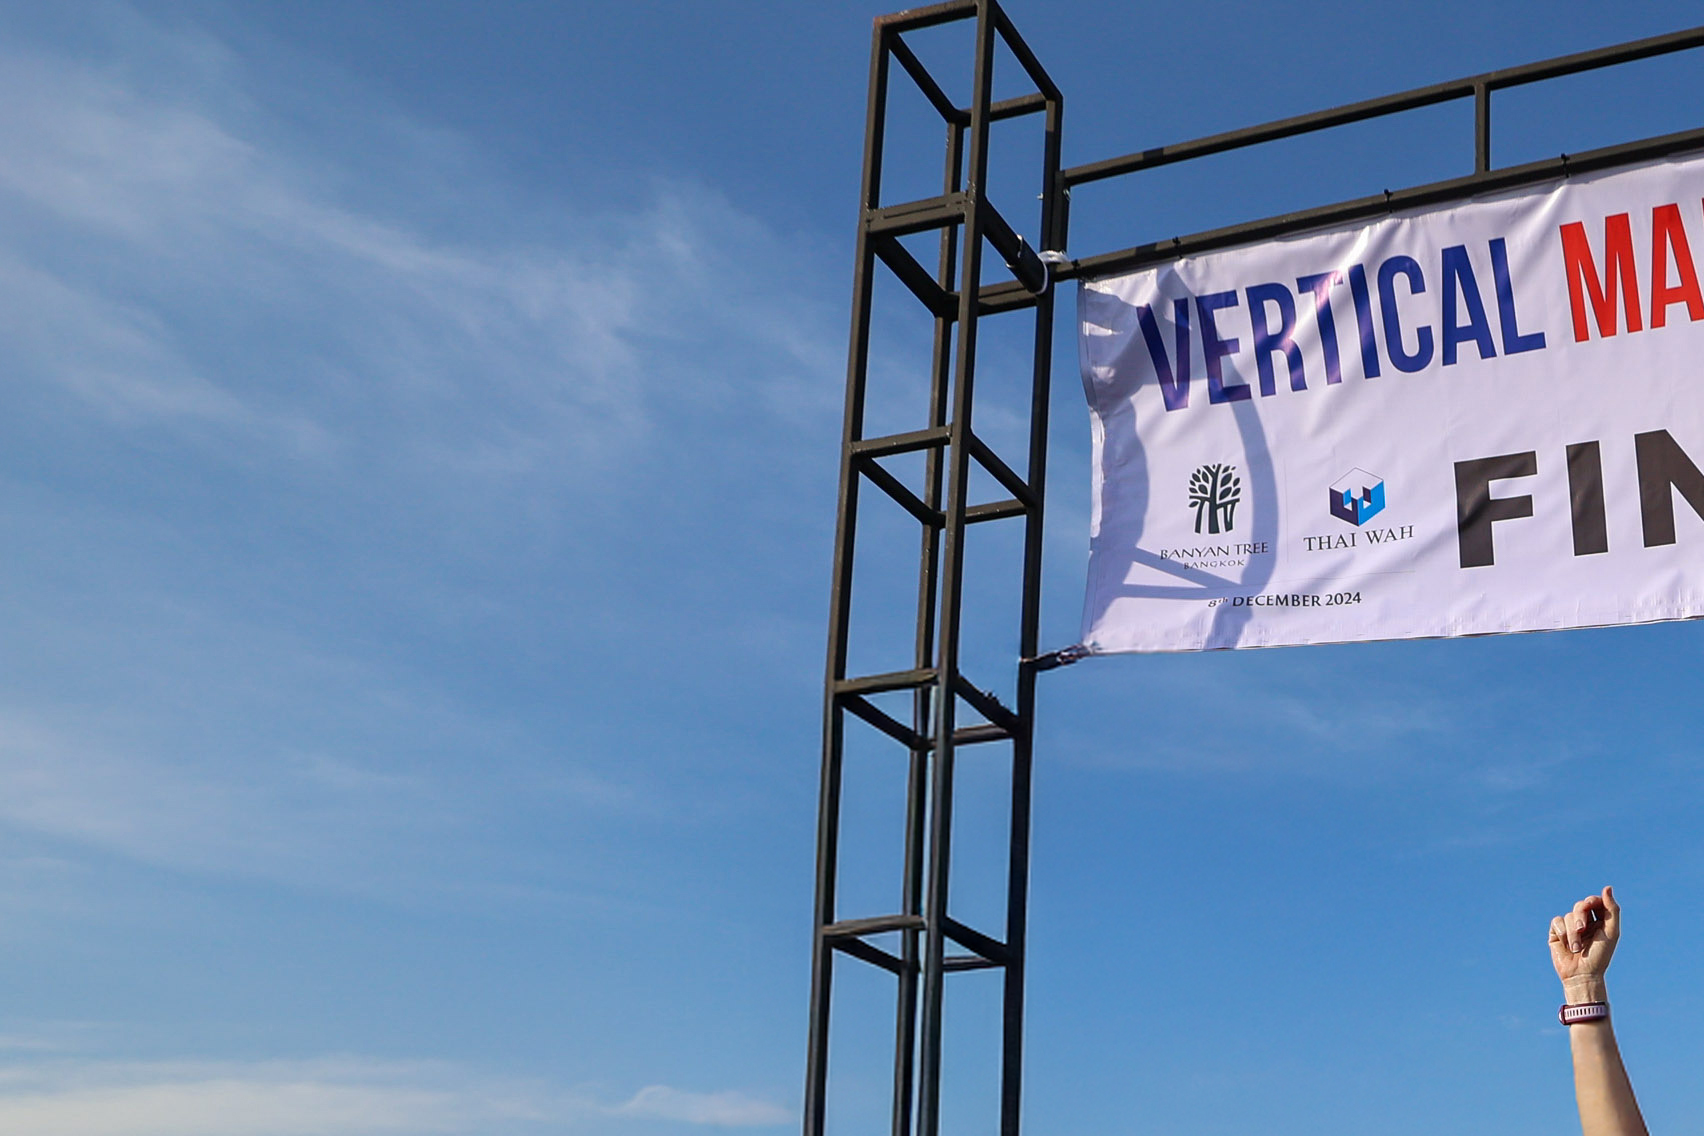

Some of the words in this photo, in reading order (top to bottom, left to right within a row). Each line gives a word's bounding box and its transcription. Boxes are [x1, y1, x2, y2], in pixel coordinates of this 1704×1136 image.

[1137, 238, 1546, 412] VERTICAL
[1303, 532, 1357, 552] THAI
[1365, 525, 1414, 545] WAH
[1160, 545, 1230, 560] BANYAN
[1233, 541, 1269, 555] TREE
[1184, 559, 1245, 570] BANGKOK
[1208, 596, 1229, 608] 8th
[1232, 593, 1321, 607] DECEMBER
[1326, 592, 1362, 606] 2024
